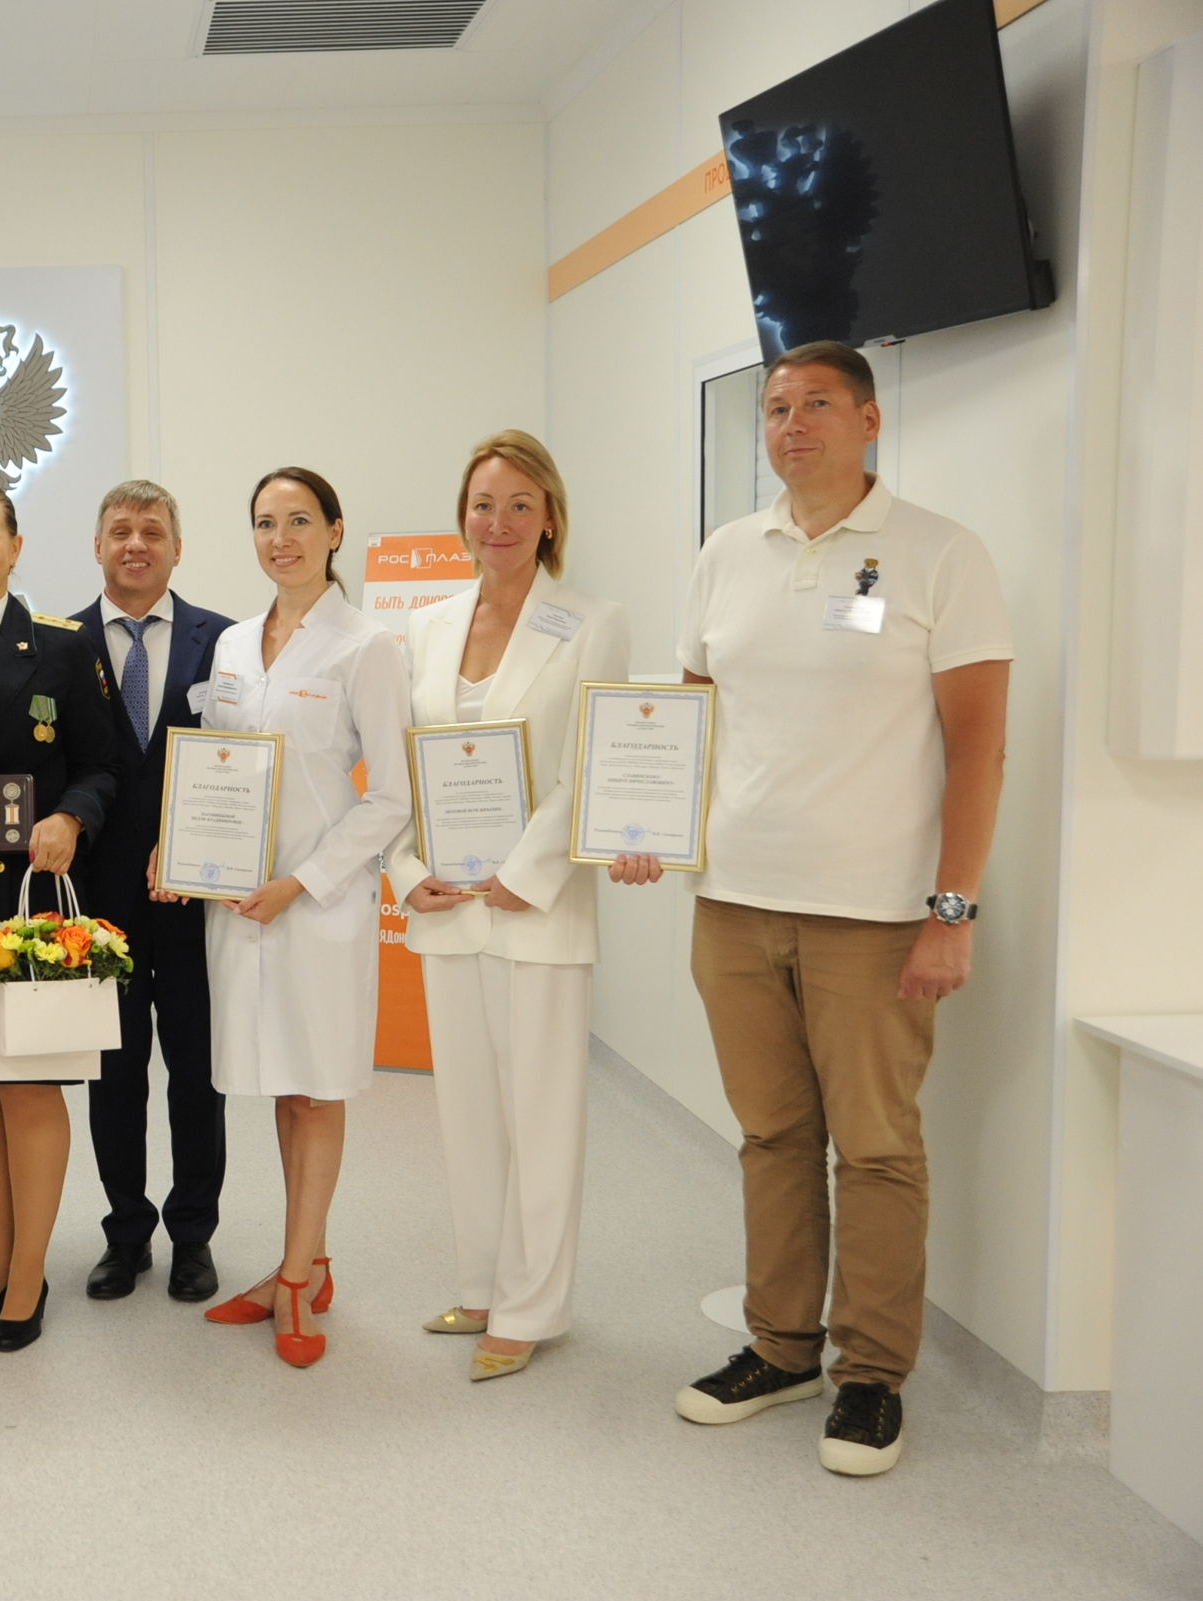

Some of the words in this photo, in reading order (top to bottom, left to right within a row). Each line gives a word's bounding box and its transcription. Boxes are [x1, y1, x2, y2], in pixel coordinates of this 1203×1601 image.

[703, 161, 732, 193] ПРО
[425, 552, 472, 563] ПЛАЗ
[374, 595, 404, 609] БЫТЬ
[610, 741, 679, 751] БЛАГОДАРНОСТЬ
[192, 783, 251, 793] БЛАГОДАРНОСТЬ
[442, 778, 503, 788] БЛАГОДАРНОСТЬ
